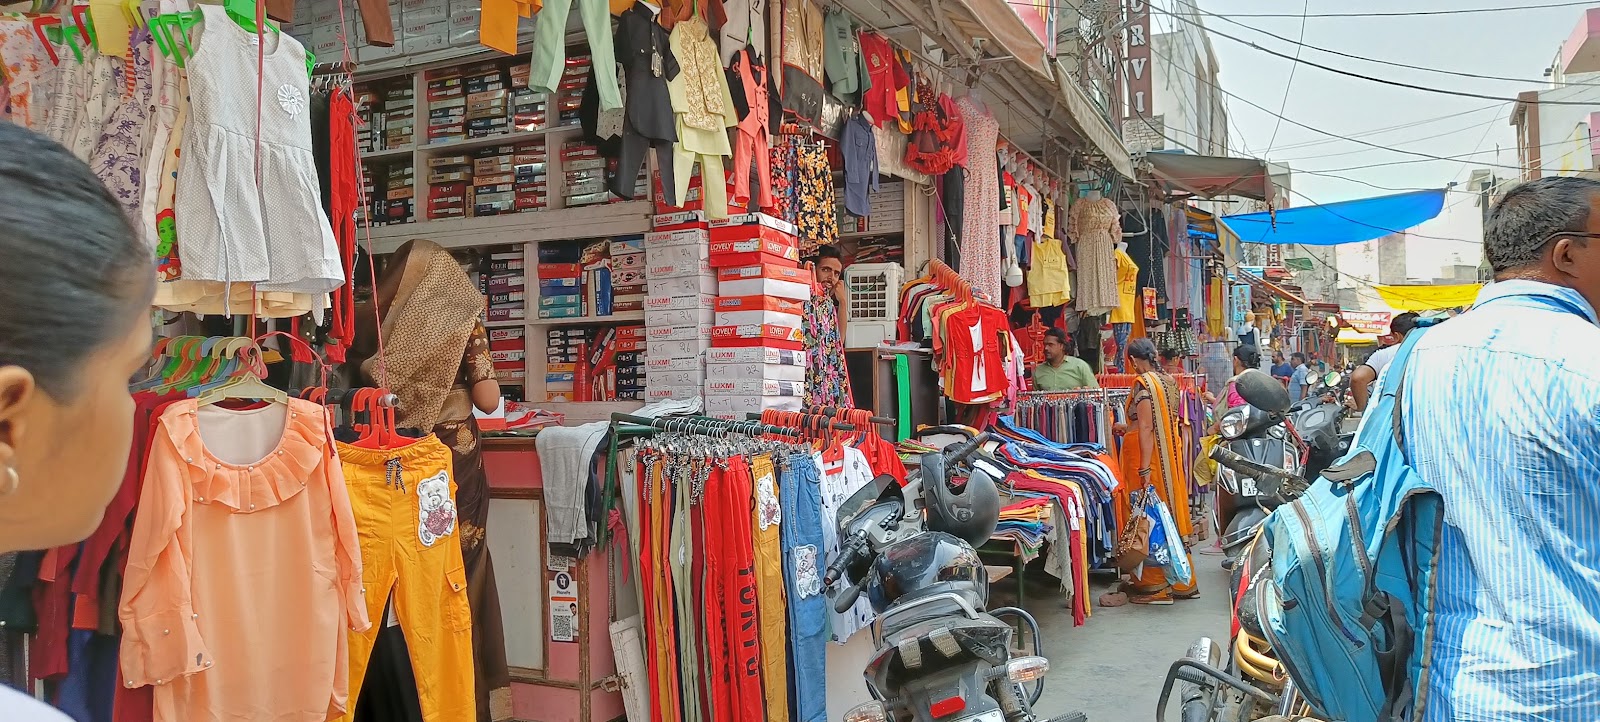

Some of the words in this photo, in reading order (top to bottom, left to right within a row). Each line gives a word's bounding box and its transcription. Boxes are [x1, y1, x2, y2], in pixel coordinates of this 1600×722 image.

[453, 15, 474, 24] LUXMI
[405, 25, 426, 33] LUXMI
[647, 233, 672, 242] LUXMI
[710, 242, 733, 251] LOVELY
[650, 265, 674, 274] LUXMI
[488, 277, 507, 286] LOVELY
[647, 297, 671, 305] LUXMI
[489, 309, 508, 317] LOVELY
[491, 330, 508, 338] Gaba
[649, 328, 672, 336] LUXMI
[712, 327, 734, 336] LOVELY
[769, 326, 785, 335] LOVELY
[710, 351, 736, 359] LUXMI
[647, 359, 671, 367] LUXMI
[709, 382, 735, 390] LUXMI
